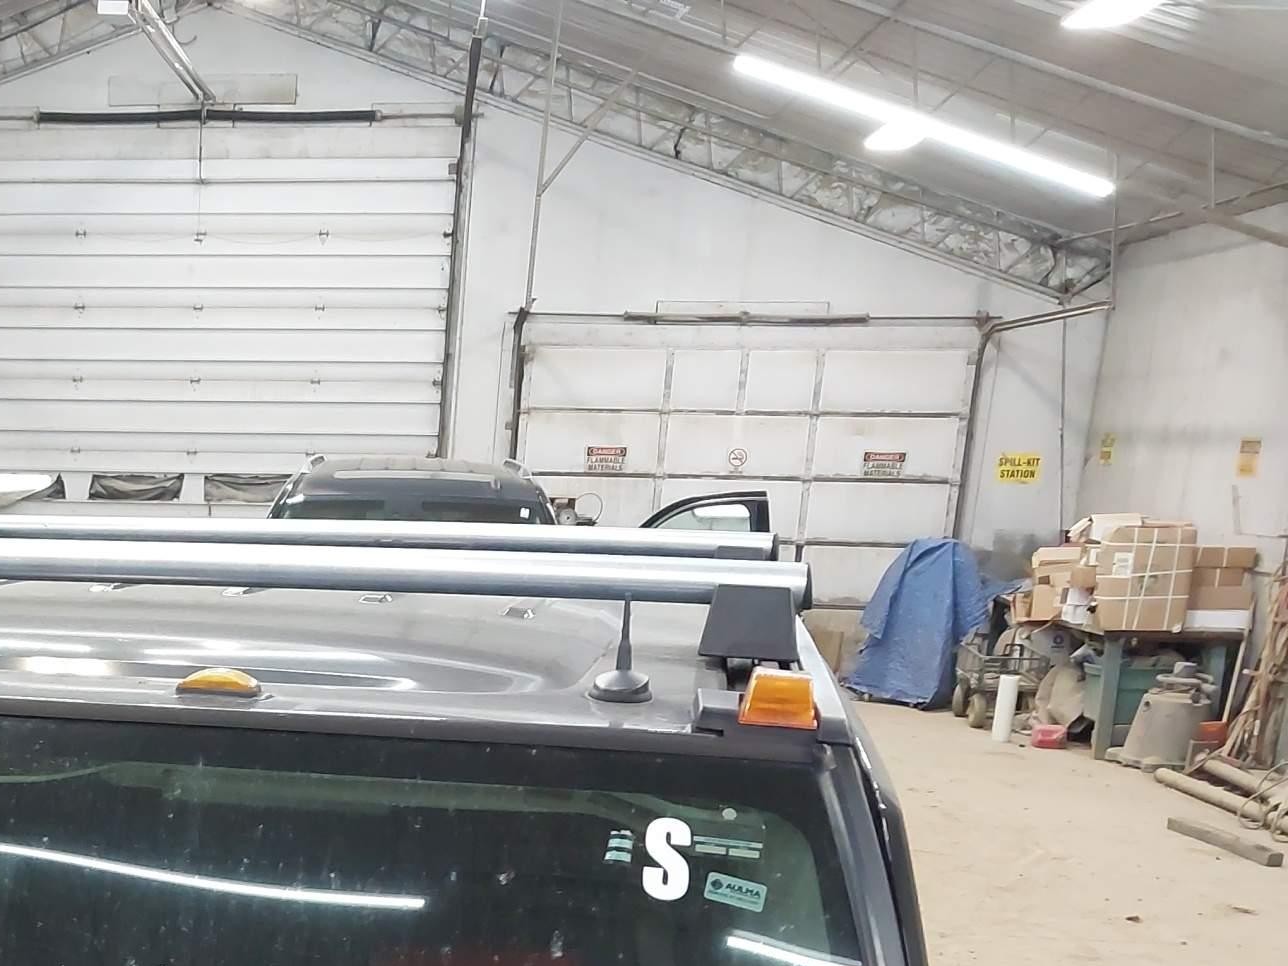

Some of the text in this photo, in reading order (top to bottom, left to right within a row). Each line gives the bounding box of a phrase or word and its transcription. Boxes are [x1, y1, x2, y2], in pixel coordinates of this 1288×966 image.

[586, 455, 624, 464] FLAMMABLE
[999, 457, 1041, 467] SPILL-KIT
[999, 469, 1036, 479] STATION
[642, 817, 692, 901] S
